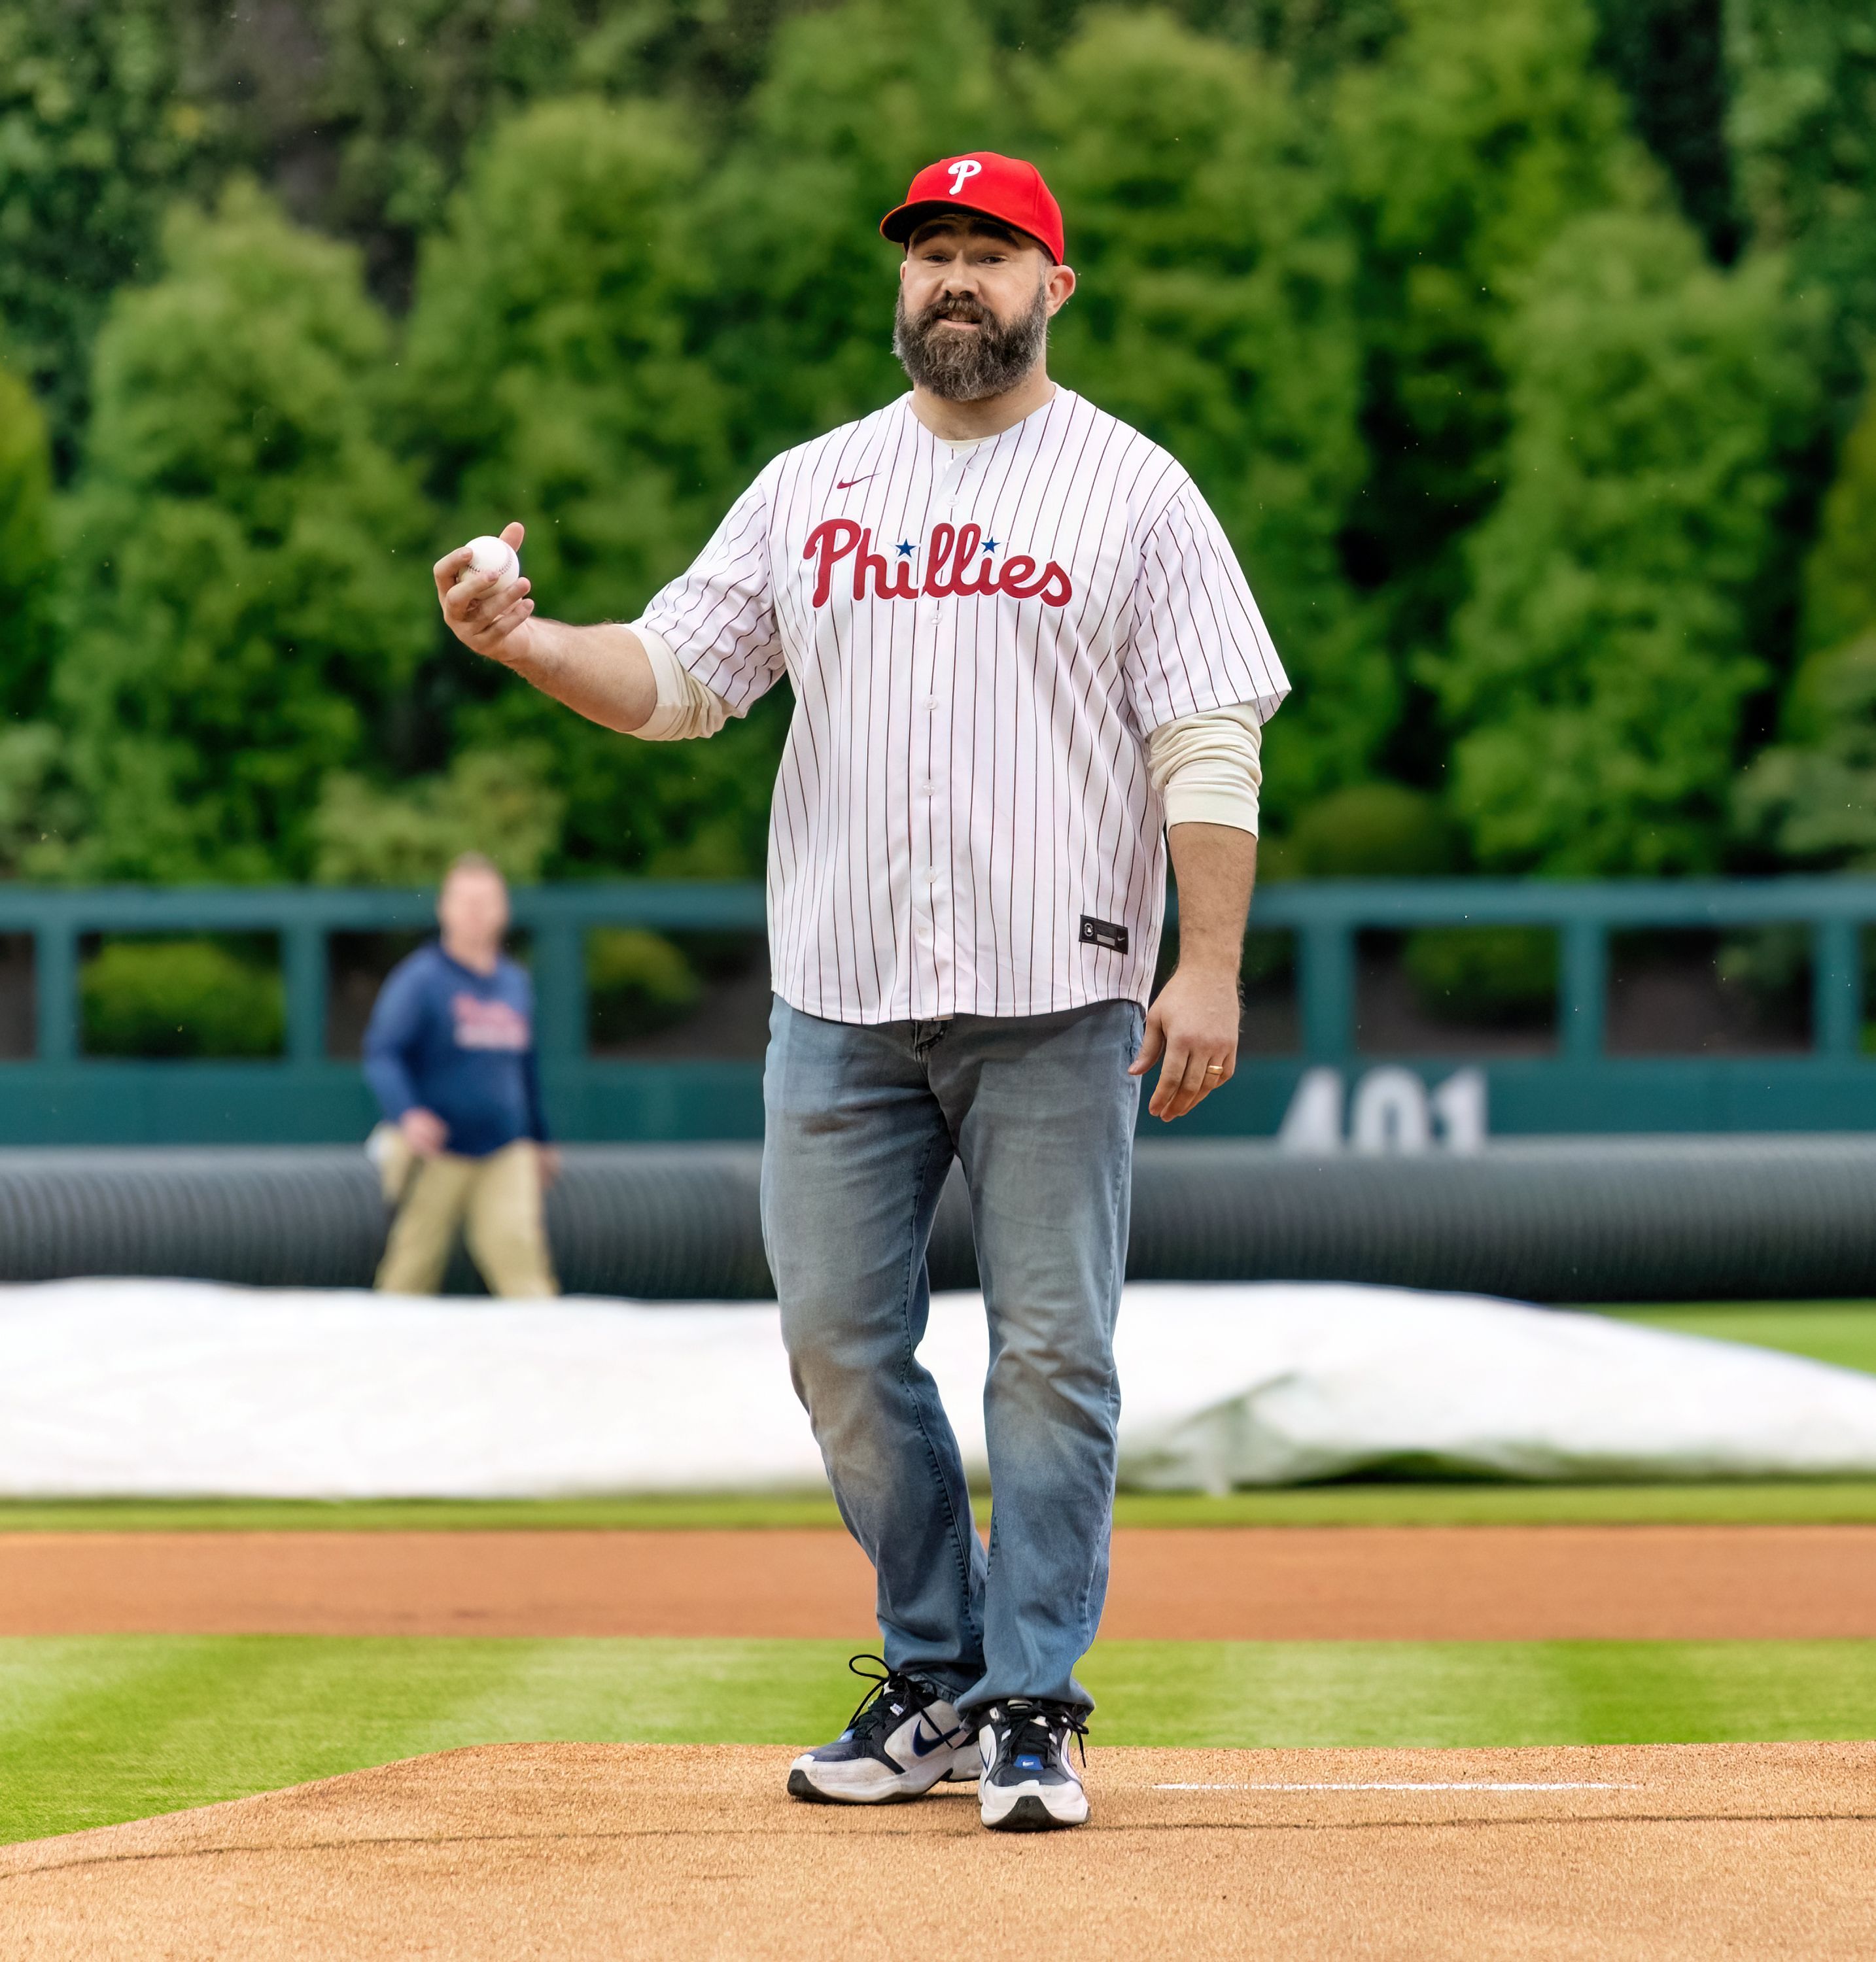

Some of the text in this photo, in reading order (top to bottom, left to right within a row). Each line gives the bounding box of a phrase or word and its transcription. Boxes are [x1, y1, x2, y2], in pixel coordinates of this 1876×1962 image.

[948, 160, 982, 195] P
[803, 518, 1073, 608] Phillies
[1279, 1067, 1489, 1156] 401
